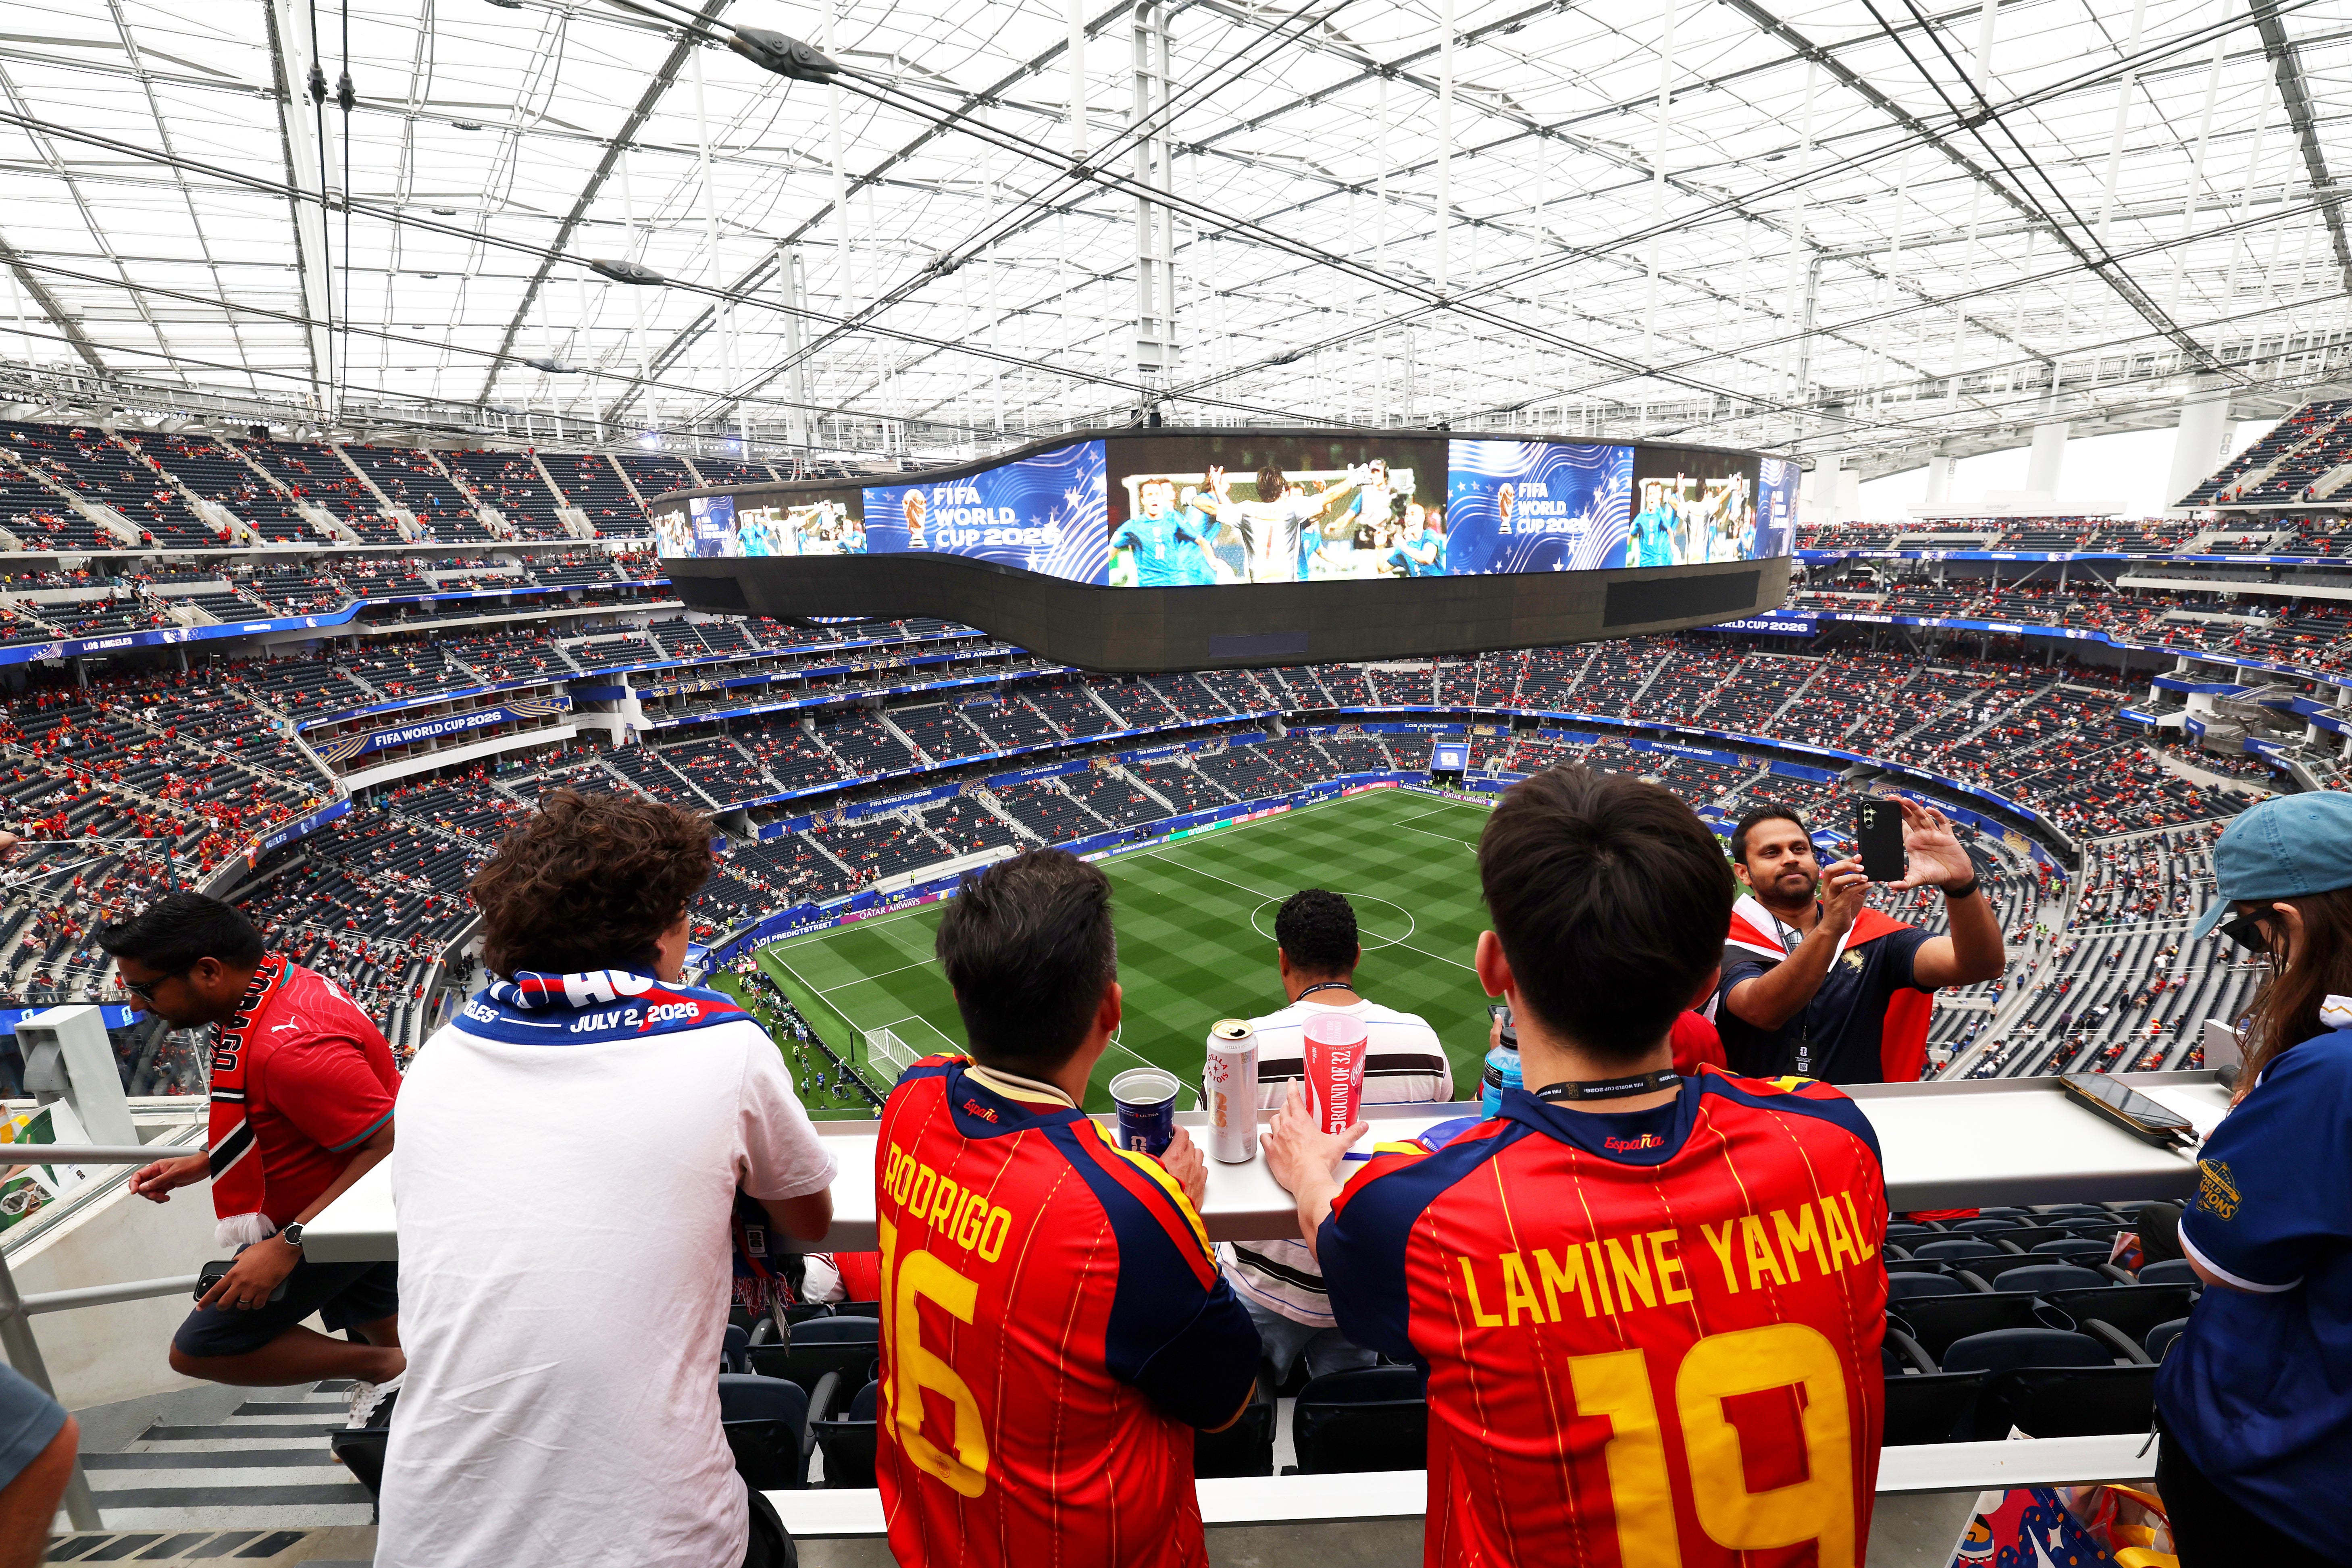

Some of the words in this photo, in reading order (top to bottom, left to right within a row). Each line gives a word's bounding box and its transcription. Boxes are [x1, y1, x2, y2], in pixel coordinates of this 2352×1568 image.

[933, 487, 982, 505] FIFA
[1519, 482, 1548, 498] FIFA
[933, 507, 1015, 526] WORLD
[1518, 500, 1567, 515] WORLD
[1517, 518, 1544, 533] CUP
[1546, 518, 1590, 533] 2026
[936, 529, 980, 548] CUP
[983, 527, 1061, 545] 2026
[1746, 621, 1768, 629] CUP
[1769, 622, 1808, 632] 2026
[1854, 614, 1892, 623] ANGELES
[83, 641, 99, 650] LOS
[100, 637, 133, 649] ANGELES
[973, 649, 1010, 657] ANGELES
[770, 672, 801, 681] #FIFAWorldCup
[375, 732, 402, 747] FIFA
[402, 724, 443, 741] WORLD
[443, 719, 465, 731] CUP
[466, 711, 502, 726] 2026
[1034, 765, 1062, 773] ANGELES
[882, 796, 902, 805] WORLD
[914, 790, 932, 798] 2026
[1412, 786, 1440, 795] PREDICTSTREET
[1443, 792, 1461, 800] QATAR
[1463, 794, 1486, 805] AIRWAYS
[1913, 793, 1925, 801] LOS
[1926, 798, 1957, 812] ANGELES
[1188, 824, 1215, 836] aramco
[859, 907, 886, 919] QATAR
[889, 898, 920, 912] AIRWAYS
[772, 921, 833, 942] PREDICTSTREET
[570, 1009, 620, 1034] JULY
[624, 1008, 644, 1029] 2,
[647, 1002, 699, 1023] 2026
[1208, 1054, 1228, 1070] STELLA
[1331, 1050, 1351, 1065] 32
[1208, 1065, 1228, 1083] ARTOIS
[1332, 1066, 1349, 1081] OF
[963, 1098, 998, 1124] España
[1331, 1083, 1349, 1121] ROUND
[1604, 1133, 1664, 1154] España
[2202, 1175, 2221, 1194] ORLD
[883, 1142, 1012, 1264] RODRIGO
[1458, 1229, 1693, 1327] LAMINE
[1700, 1190, 1875, 1295] YAMAL
[879, 1210, 990, 1498] 16
[1567, 1323, 1855, 1568] 19
